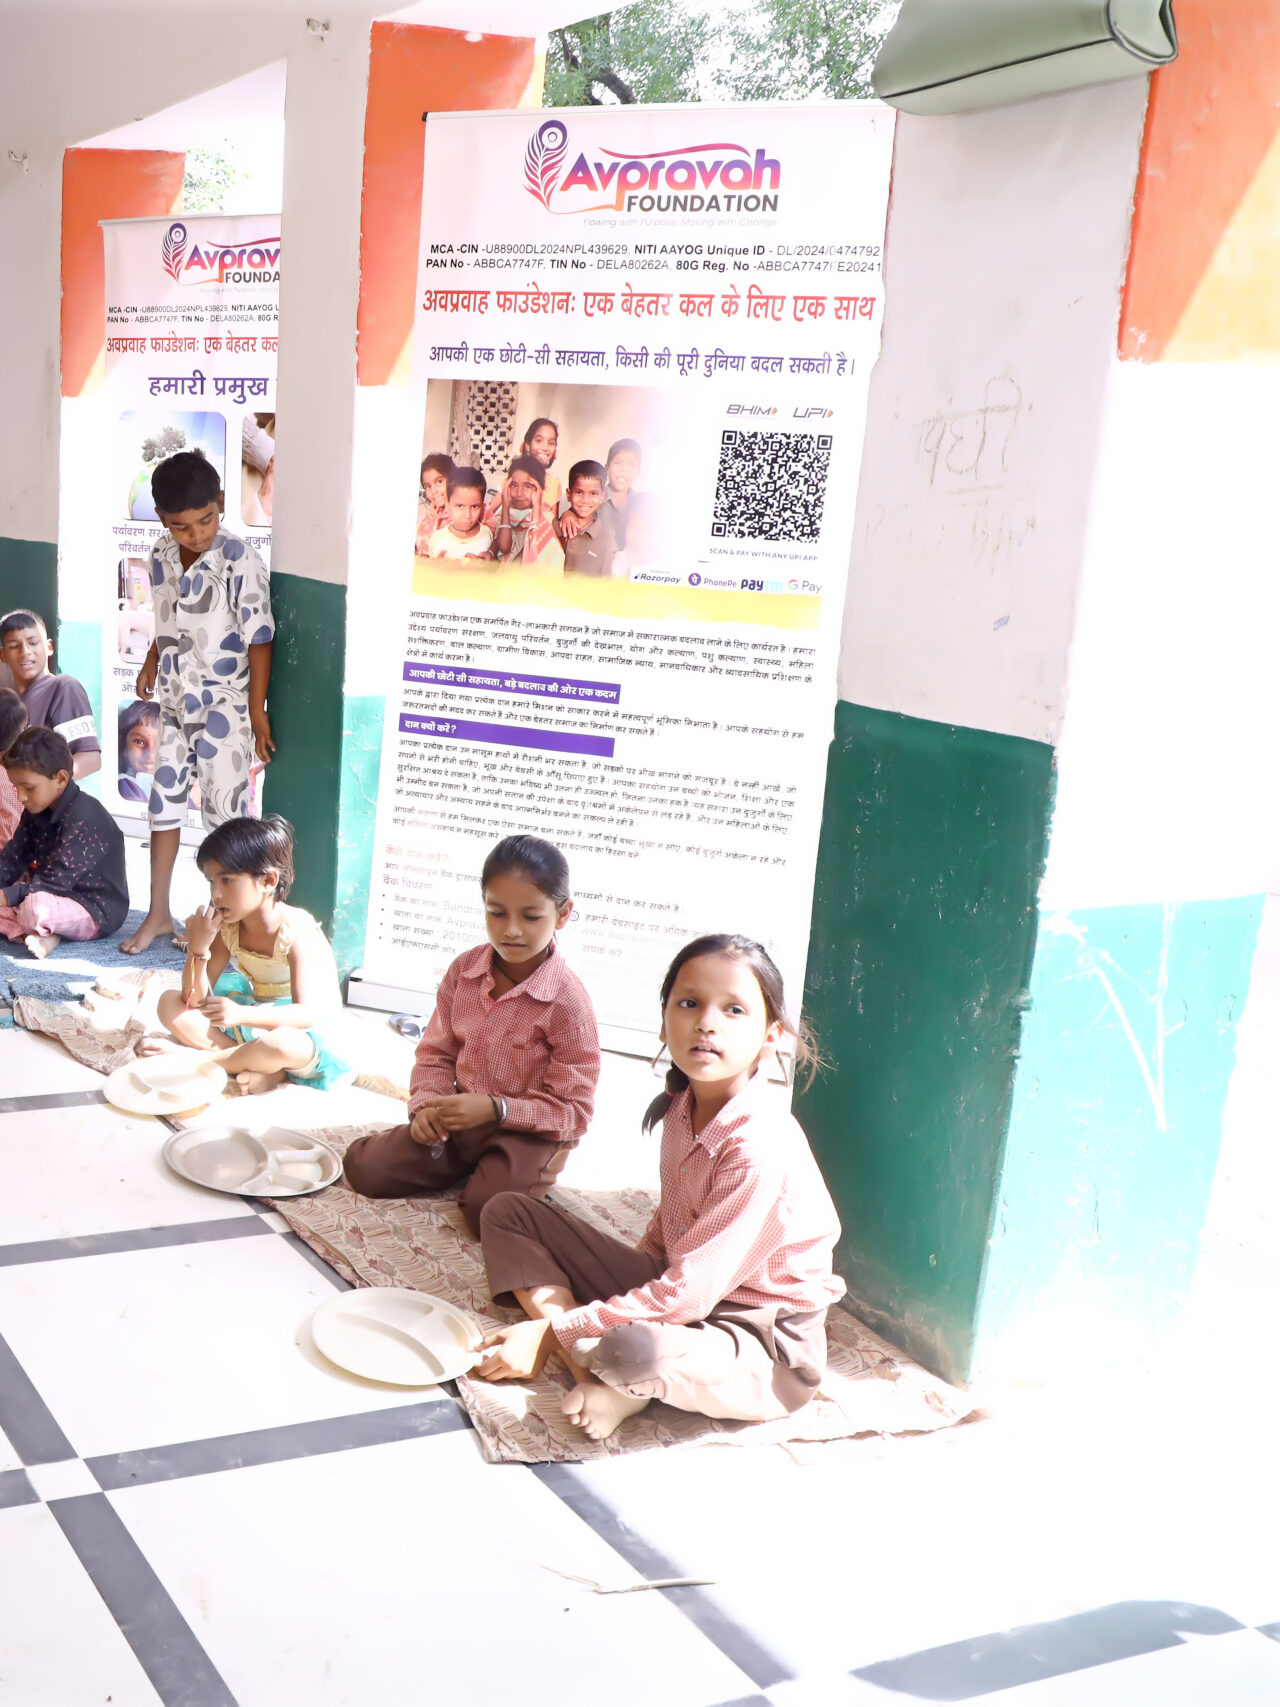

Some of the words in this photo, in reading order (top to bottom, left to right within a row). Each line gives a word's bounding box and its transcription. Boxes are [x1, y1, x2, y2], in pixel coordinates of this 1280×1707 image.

[559, 148, 781, 212] Avpravah
[627, 194, 779, 213] FOUNDATION
[430, 243, 455, 255] MCA
[634, 243, 658, 255] NITI
[658, 244, 704, 256] AAYOG
[706, 244, 750, 257] Unique
[752, 244, 766, 256] ID
[184, 244, 281, 283] Avprav
[425, 258, 448, 269] PAN
[449, 258, 465, 269] No
[549, 258, 568, 270] TIN
[570, 258, 587, 270] No
[675, 259, 700, 271] 80G
[702, 259, 729, 274] Reg.
[732, 260, 750, 272] No
[225, 271, 280, 284] FOUNDA
[108, 304, 122, 314] MCA
[231, 304, 246, 313] NITI
[247, 304, 273, 312] AAYOG
[422, 289, 492, 316] अवप्रवाह
[582, 291, 617, 318] एक
[620, 281, 674, 319] बेहतर
[678, 293, 716, 318] कल
[720, 283, 742, 319] के
[746, 283, 787, 322] लिए
[792, 295, 829, 323] एक
[833, 295, 877, 321] साथ
[107, 316, 118, 324] PAN
[181, 315, 192, 323] TIN
[194, 315, 205, 323] No
[257, 314, 271, 323] 80G
[106, 337, 147, 353] अवप्रवाह
[203, 337, 223, 354] एक
[225, 330, 257, 354] बेहतर
[428, 340, 470, 363] आपकी
[472, 347, 496, 365] एक
[554, 349, 610, 371] सहायता,
[614, 344, 650, 369] किसी
[653, 345, 673, 370] की
[675, 346, 701, 377] पूरी
[702, 347, 747, 379] दुनिया
[750, 355, 785, 374] बदल
[788, 351, 833, 375] सकती
[148, 369, 206, 396] हमारी
[213, 377, 270, 405] प्रमुख
[726, 404, 772, 416] BHIM
[792, 406, 828, 419] UPI
[112, 523, 145, 537] पर्यावरण
[709, 547, 728, 555] SCAN
[772, 552, 788, 560] ANY
[640, 572, 682, 584] Razorpay
[703, 577, 737, 589] PhonePe
[801, 580, 822, 594] Pay
[429, 624, 459, 635] पर्यावरण
[491, 631, 518, 645] जलवायु
[629, 643, 646, 654] योग
[648, 645, 664, 656] और
[701, 652, 715, 663] पशु
[788, 658, 815, 670] महिला
[409, 669, 436, 679] आपकी
[436, 670, 455, 681] छोटी
[456, 672, 467, 682] सी
[468, 675, 503, 688] सहायता,
[504, 677, 517, 690] बड़े
[517, 681, 546, 691] बदलाव
[547, 682, 559, 693] की
[560, 683, 578, 695] ओर
[578, 687, 594, 696] एक
[594, 689, 617, 699] कदम
[424, 691, 440, 704] द्वारा
[441, 690, 457, 705] दिया
[458, 694, 473, 702] गया
[474, 695, 496, 705] प्रत्येक
[532, 700, 554, 712] मिशन
[655, 714, 683, 727] भूमिका
[750, 726, 780, 737] सहयोग
[405, 720, 420, 729] दान
[420, 721, 436, 731] क्यों
